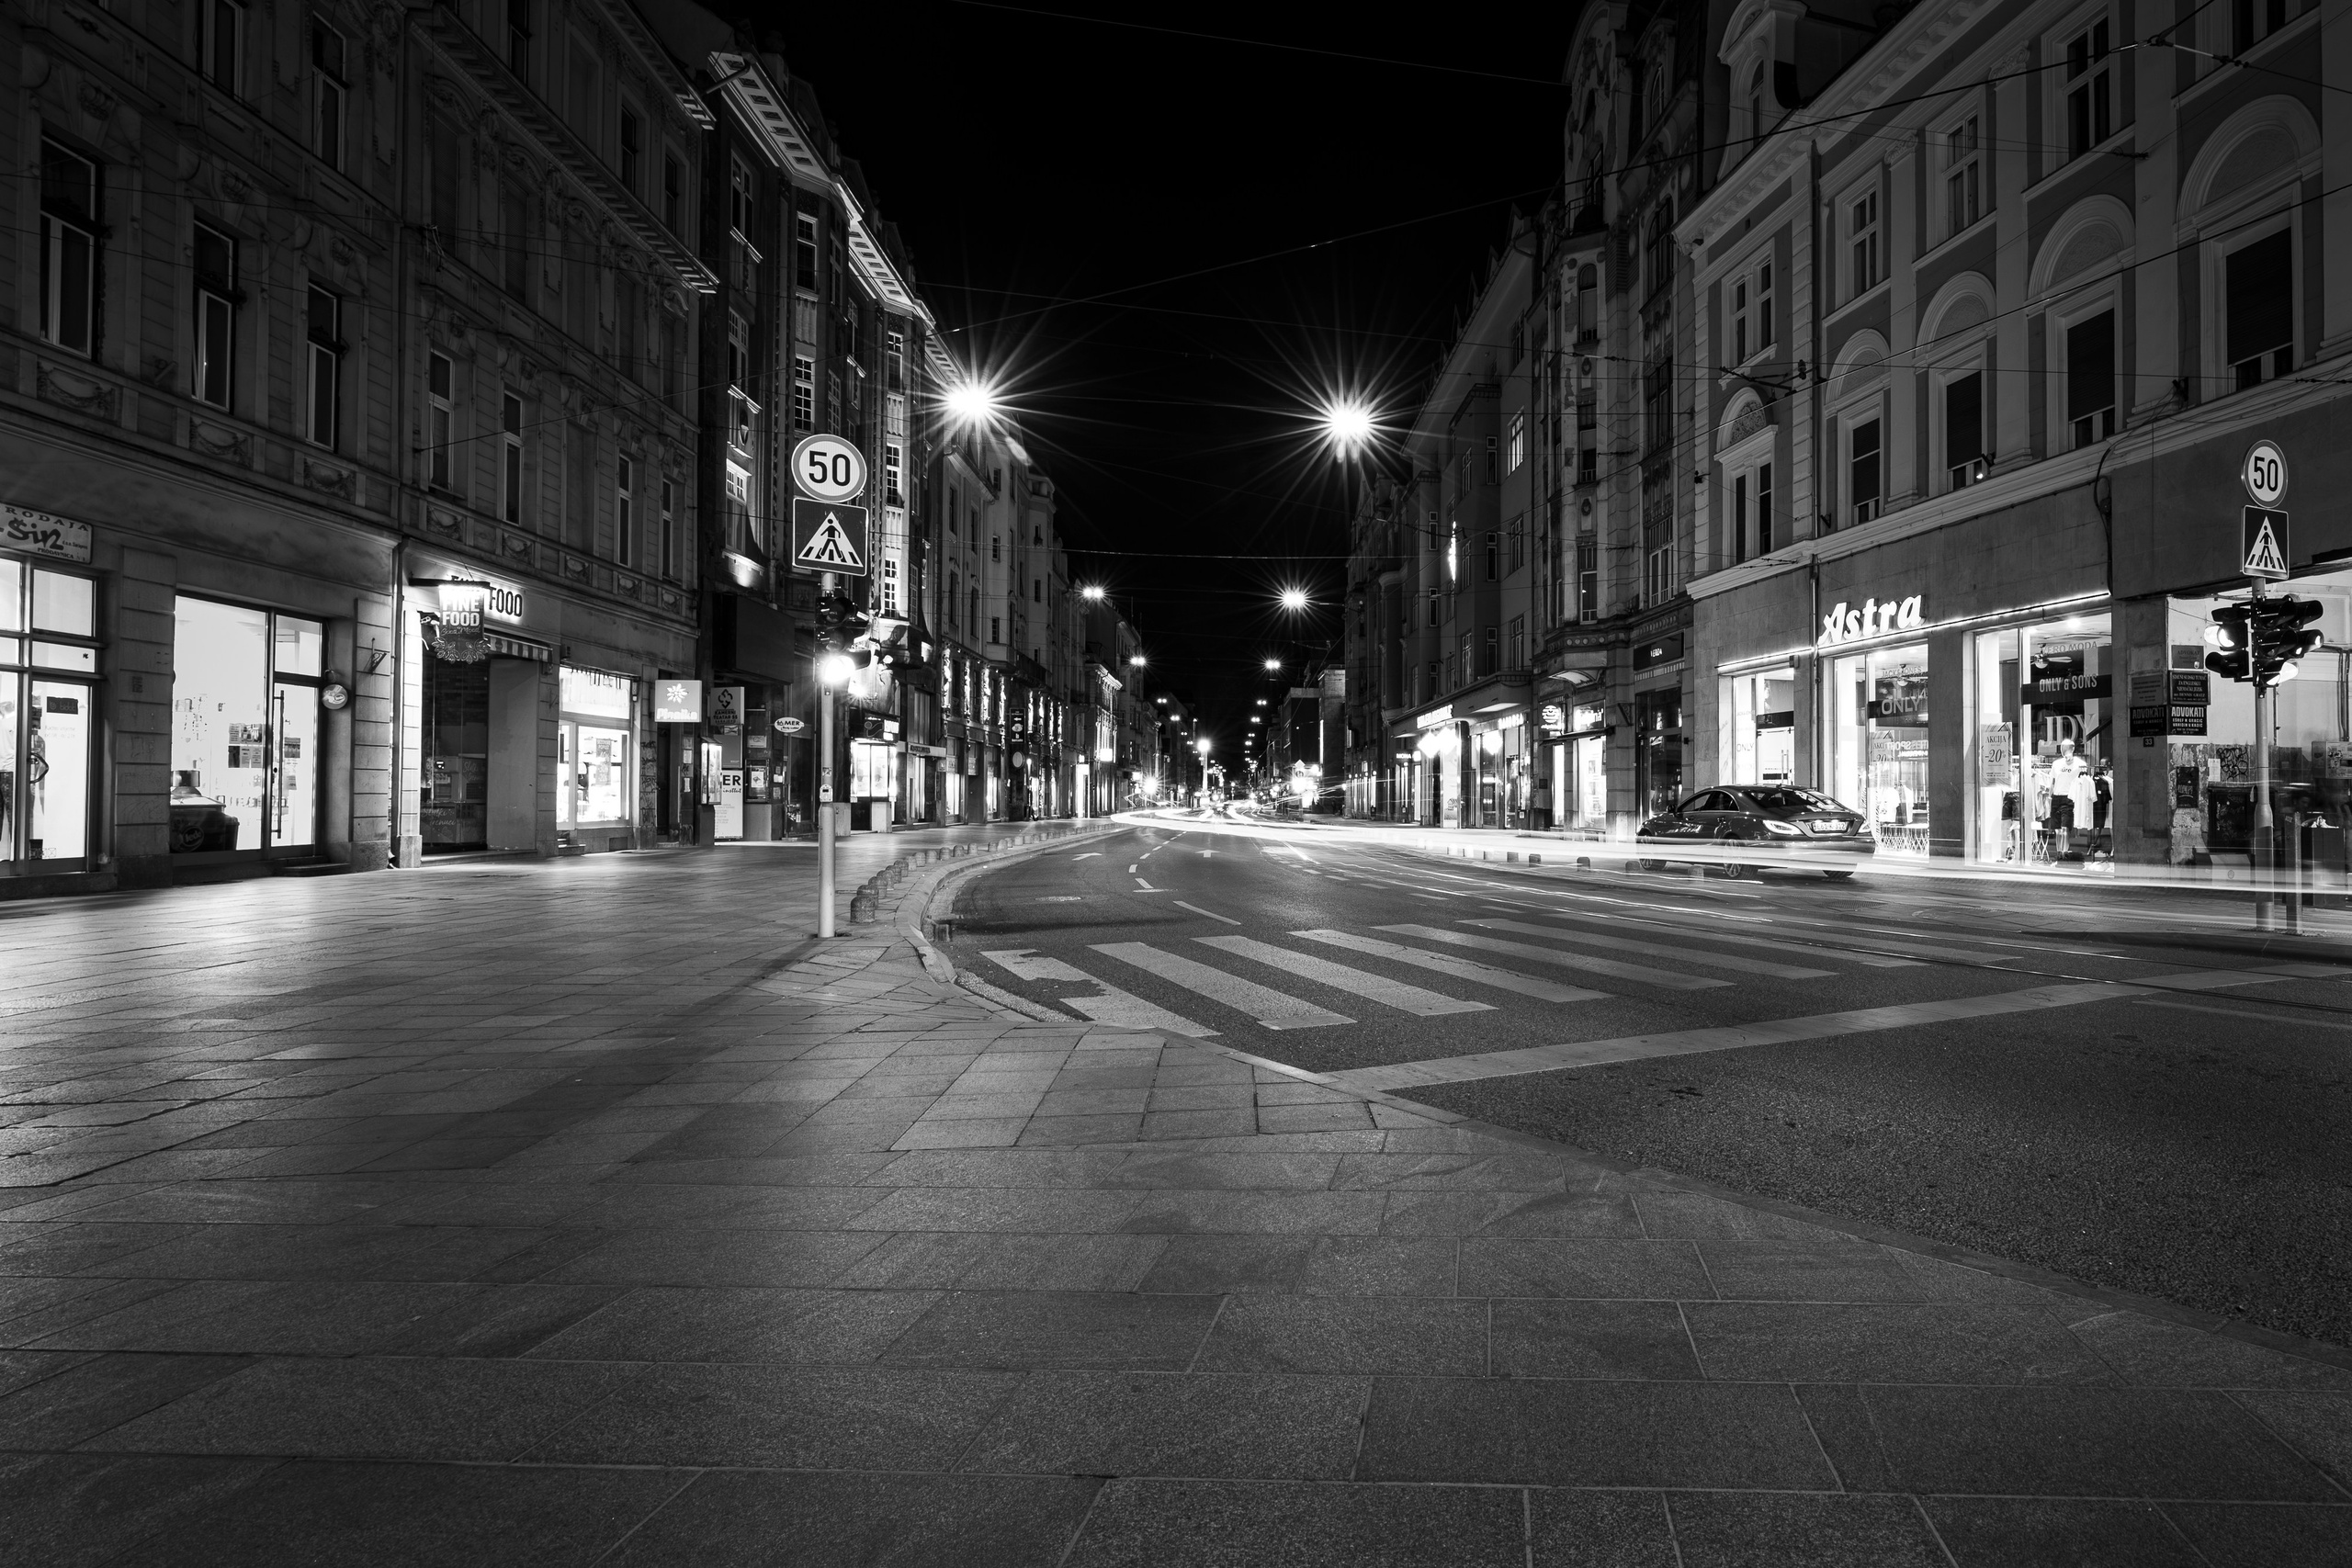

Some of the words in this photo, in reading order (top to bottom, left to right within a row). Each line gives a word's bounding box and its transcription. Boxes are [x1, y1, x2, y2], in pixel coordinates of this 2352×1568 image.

[808, 449, 851, 487] 50
[2253, 456, 2278, 492] 50
[489, 587, 523, 617] FOOD
[442, 611, 481, 626] FOOD
[1817, 594, 1923, 645] Astra
[2068, 641, 2098, 651] MODA
[2039, 677, 2063, 693] ONLY
[2064, 678, 2069, 690] &
[2071, 673, 2098, 690] SONS
[1881, 698, 1920, 715] ONLY
[2132, 707, 2164, 719] ADVOKATI
[2171, 706, 2204, 717] ADVOKATI
[2039, 713, 2097, 746] JDY
[1985, 735, 2007, 743] AKCIJA
[2144, 738, 2153, 746] 33
[1736, 742, 1756, 752] ONLY
[722, 774, 741, 786] ER
